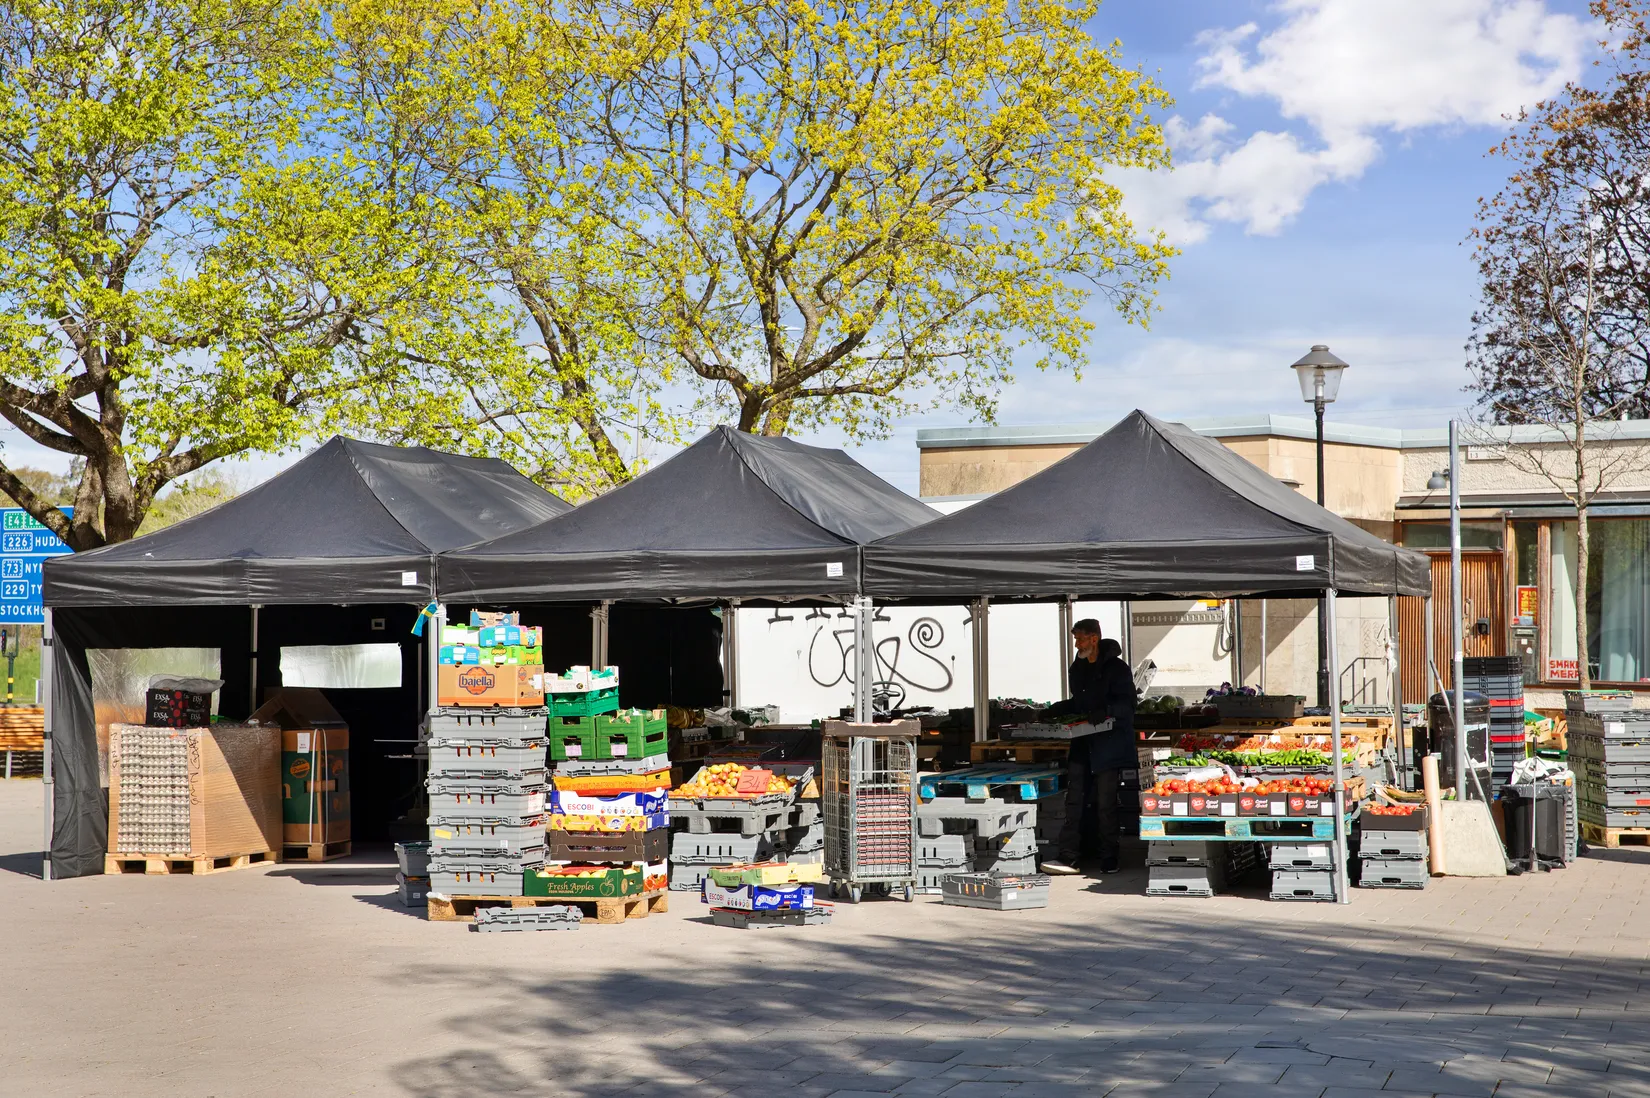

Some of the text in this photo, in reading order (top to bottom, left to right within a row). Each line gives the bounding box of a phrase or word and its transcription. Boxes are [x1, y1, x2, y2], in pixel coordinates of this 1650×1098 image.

[8, 515, 20, 526] E4
[8, 536, 67, 547] 226 HUDD
[6, 563, 19, 573] 73
[5, 584, 43, 595] 229 TY
[1521, 590, 1529, 617] MER
[461, 676, 493, 687] bajella
[567, 803, 595, 811] ESCOBI
[547, 881, 595, 894] Fresh Apples
[709, 892, 725, 901] ESCOBI
